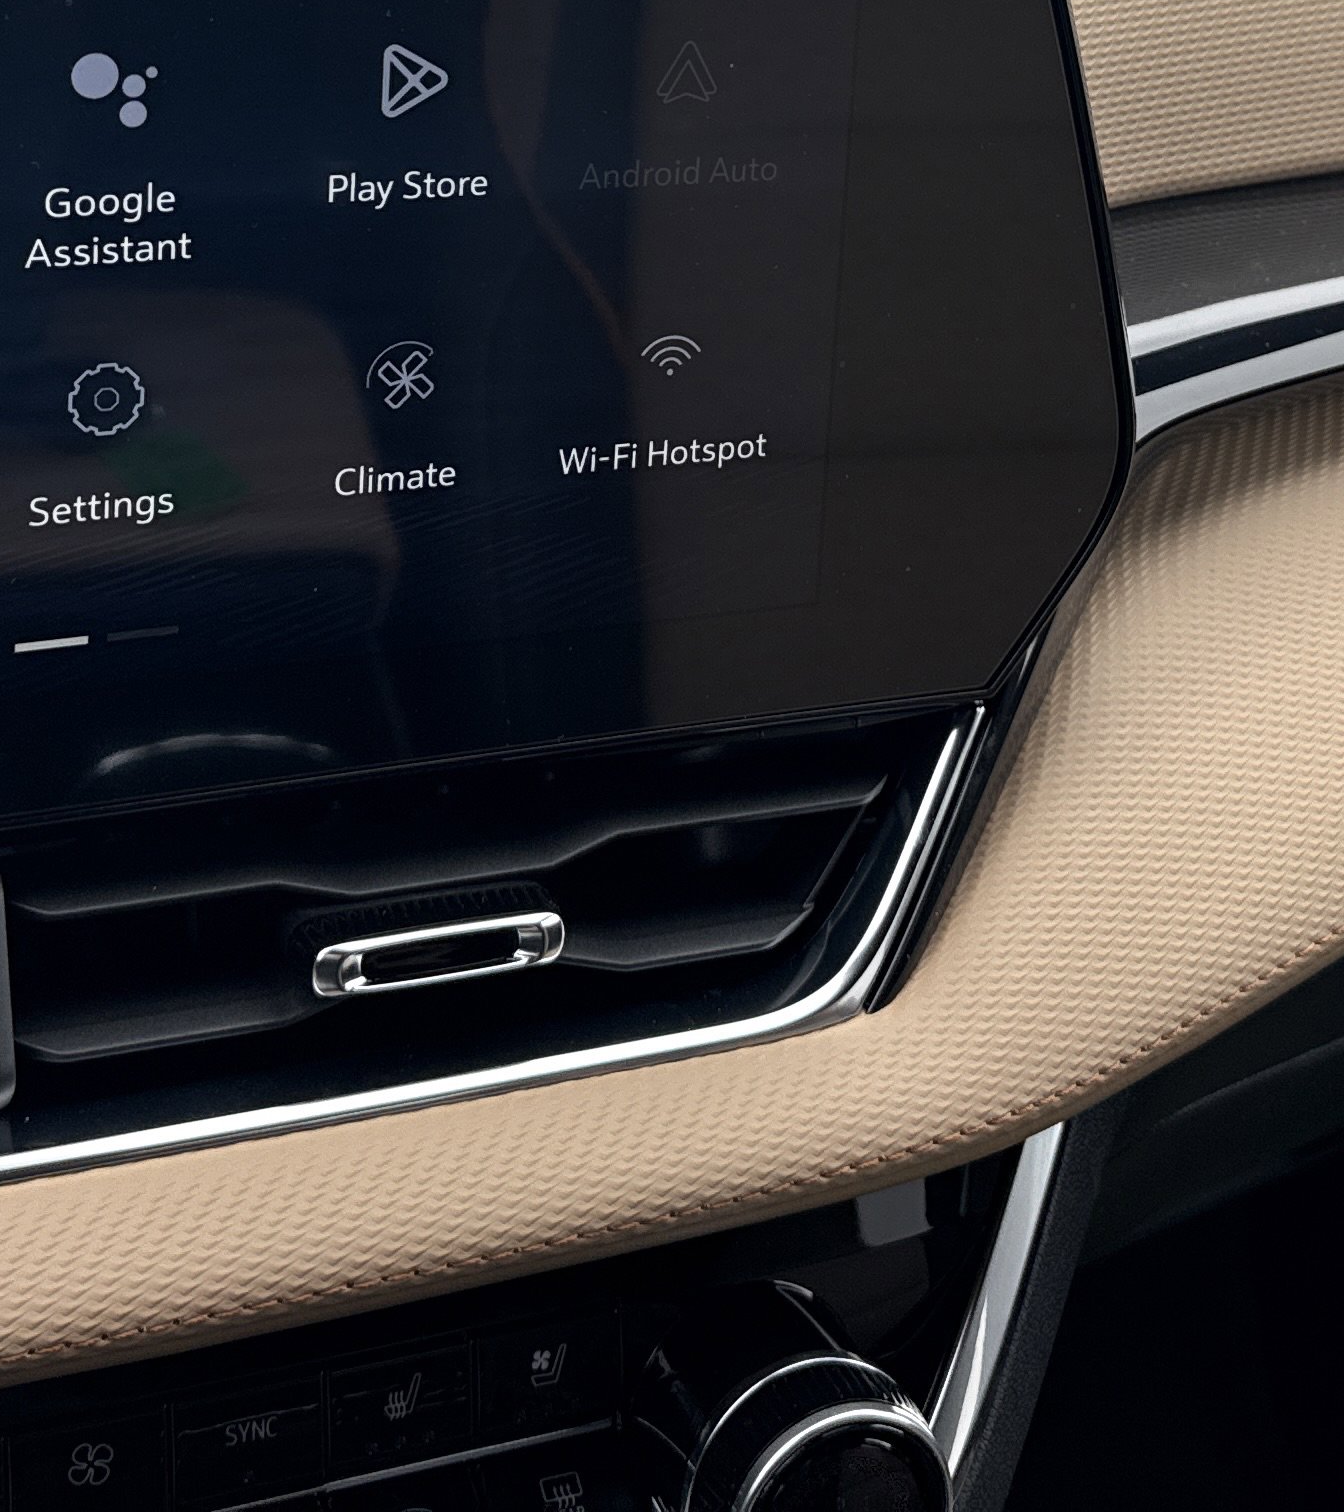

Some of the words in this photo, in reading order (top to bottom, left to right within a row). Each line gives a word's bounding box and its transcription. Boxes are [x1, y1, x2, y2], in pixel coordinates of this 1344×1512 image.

[328, 172, 394, 210] Play
[402, 170, 488, 200] Store
[578, 156, 702, 191] Android
[708, 157, 779, 184] Auto
[44, 181, 176, 223] Google
[24, 232, 192, 269] Assistant
[558, 442, 638, 475] Wi-Fi
[647, 433, 767, 469] Hotspot
[334, 462, 456, 497] Climate
[28, 491, 175, 527] Settings
[225, 1415, 277, 1446] SYNC
